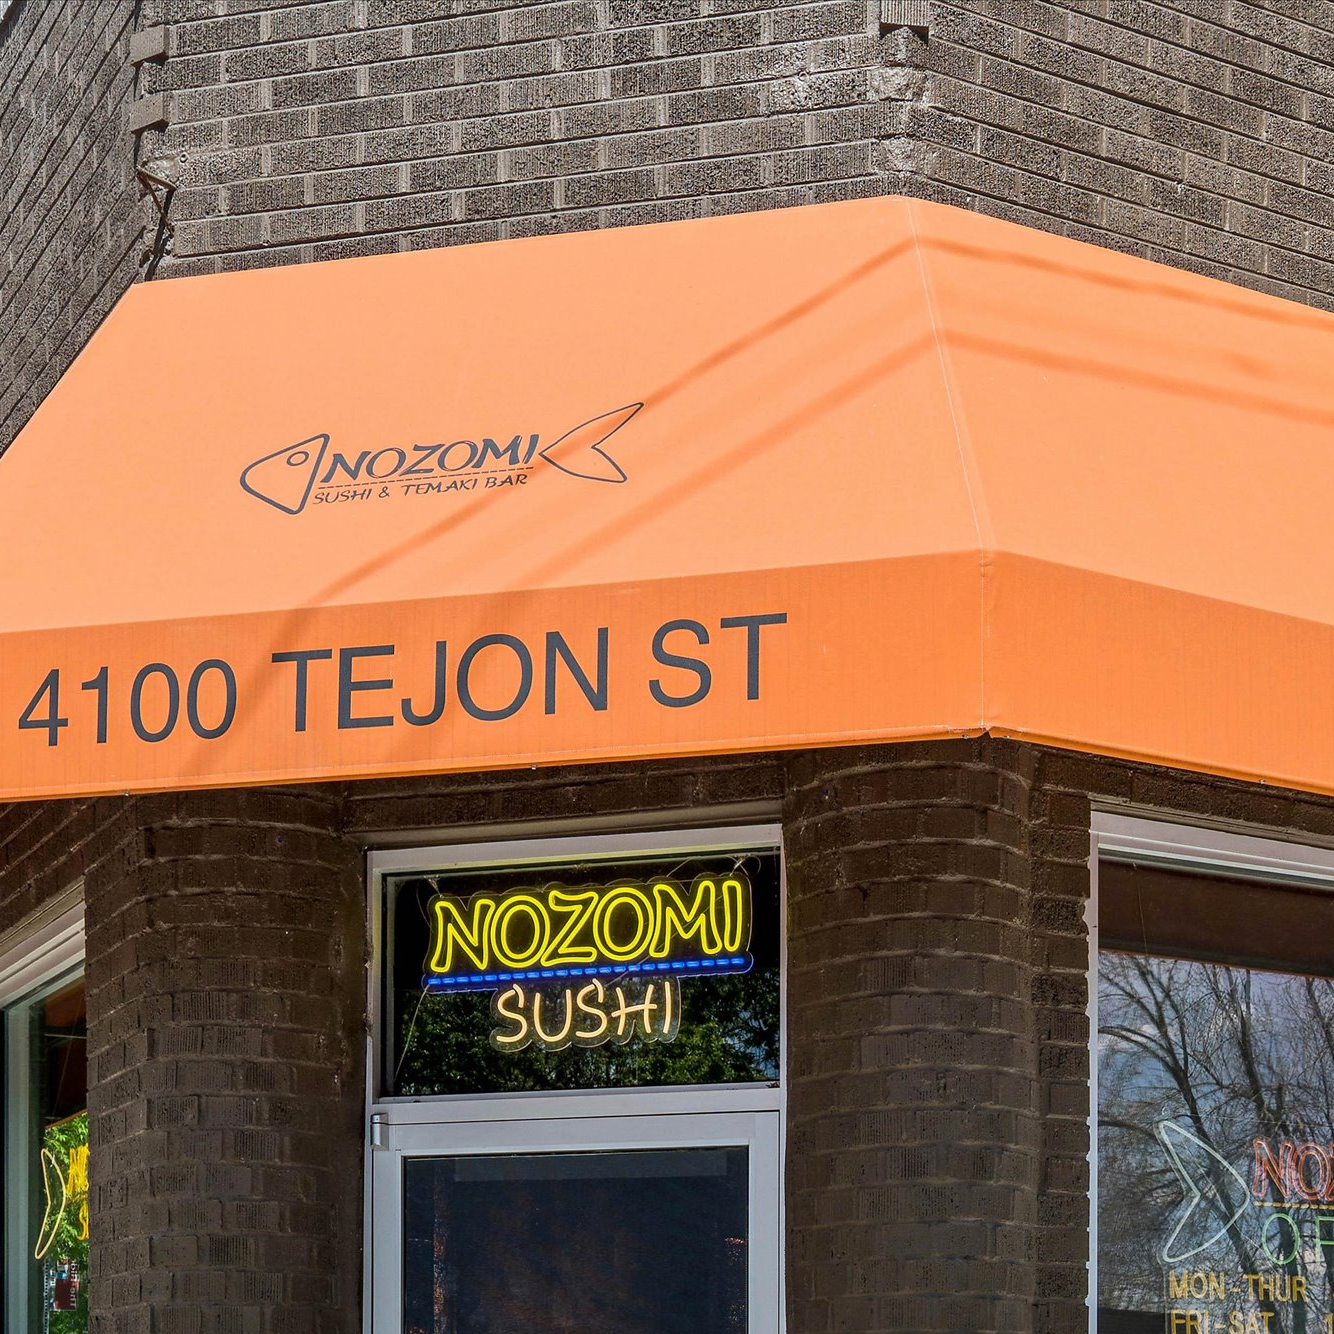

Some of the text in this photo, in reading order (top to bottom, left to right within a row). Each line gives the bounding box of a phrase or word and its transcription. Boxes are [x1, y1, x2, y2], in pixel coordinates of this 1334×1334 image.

[312, 473, 528, 504] SUSHI & TEMAKI BAR
[322, 434, 539, 482] NOZOMI
[18, 612, 788, 746] 4100 TEJON ST
[430, 879, 742, 973] NOZOMI
[496, 978, 672, 1042] SUSHI
